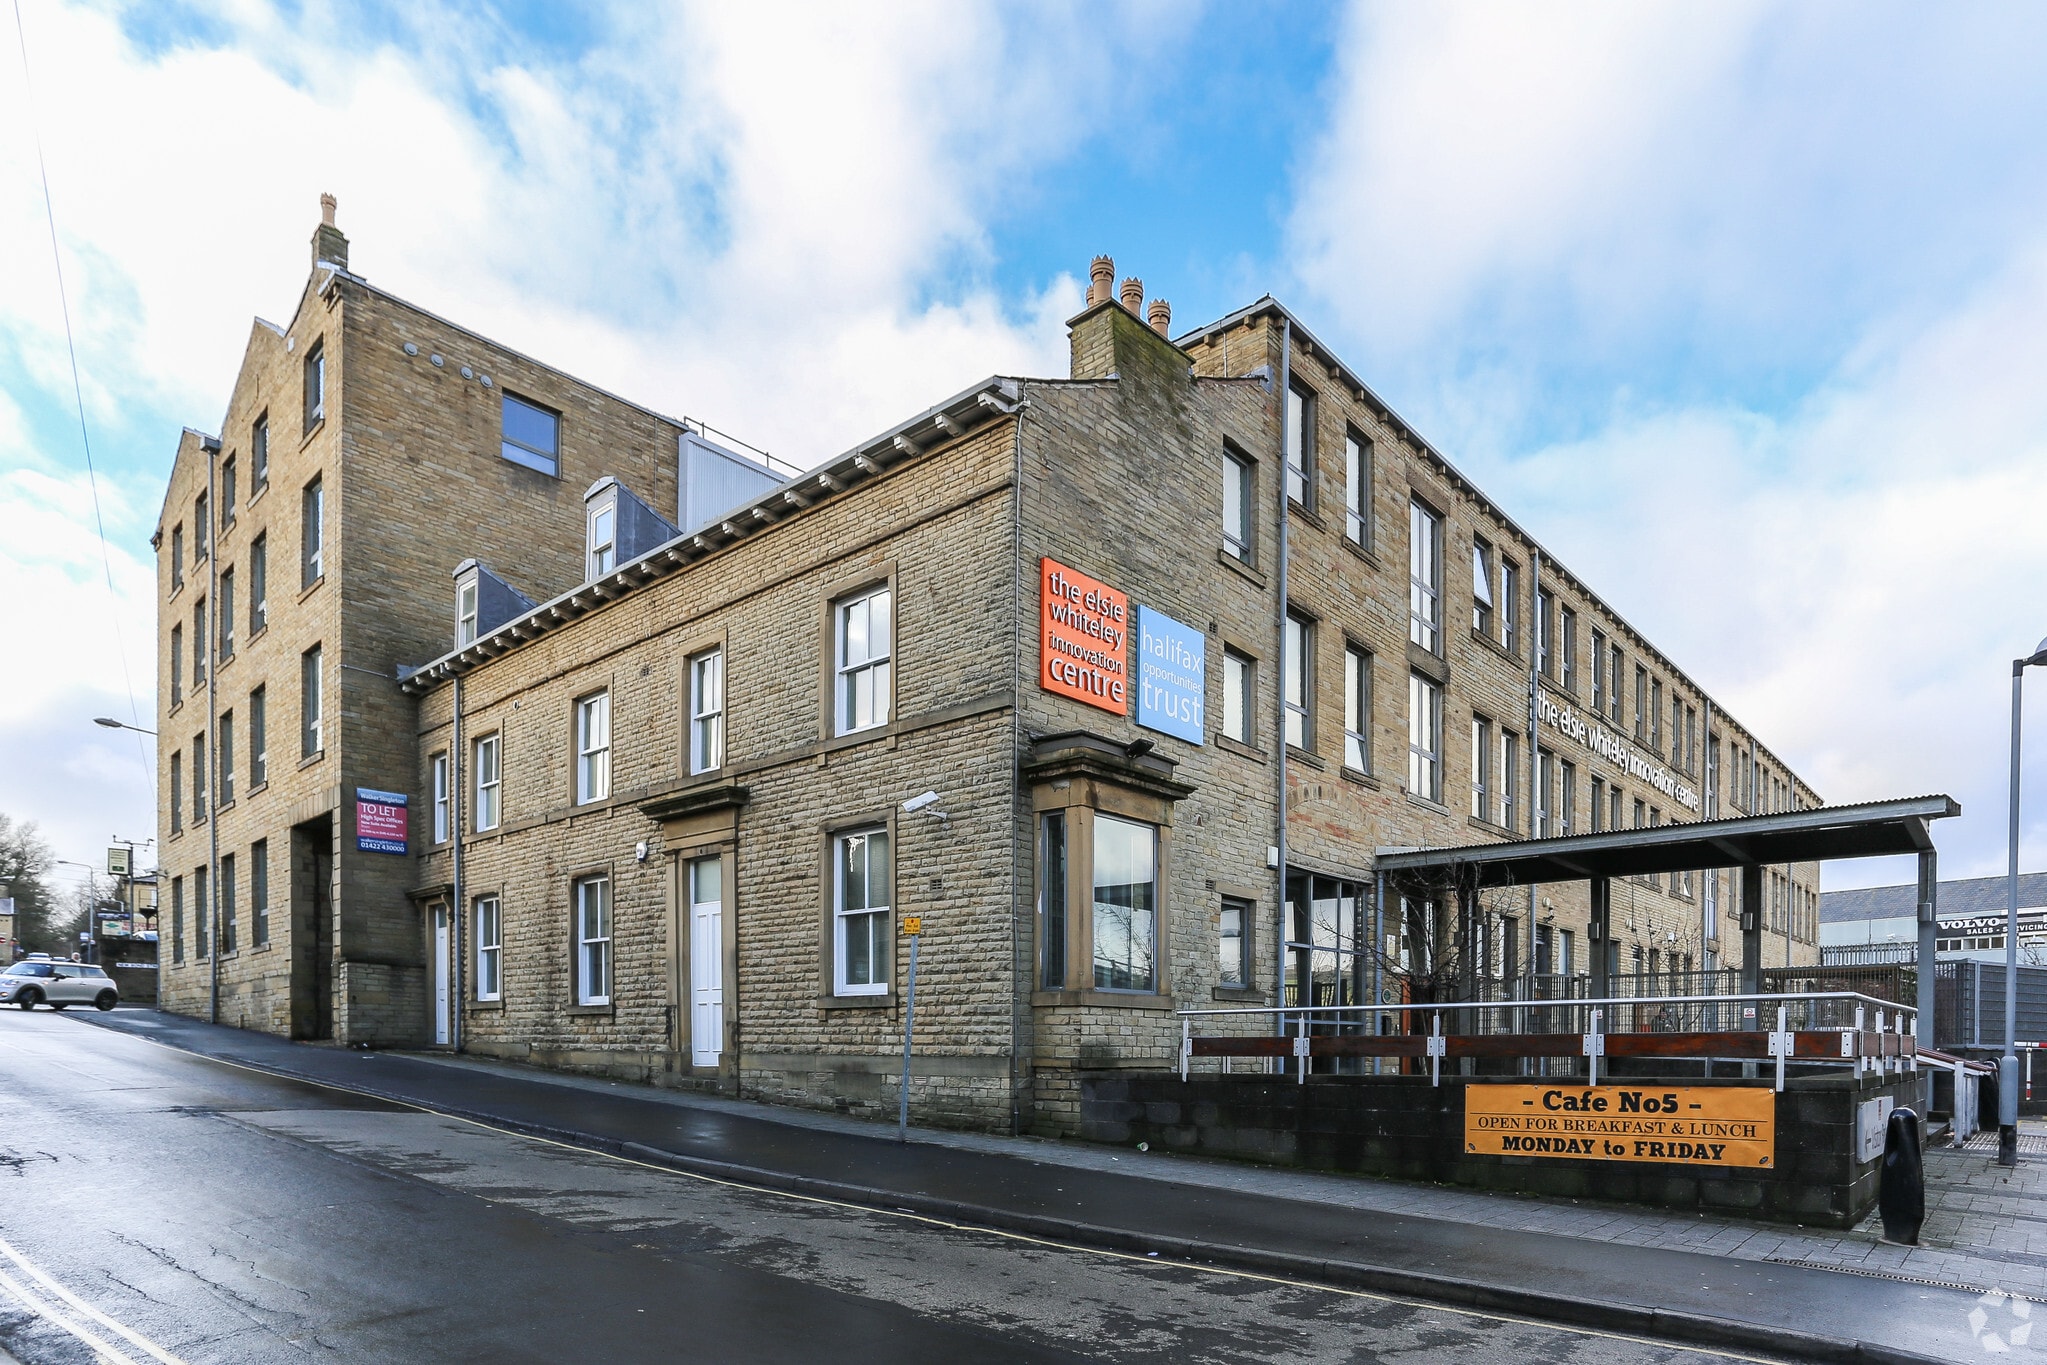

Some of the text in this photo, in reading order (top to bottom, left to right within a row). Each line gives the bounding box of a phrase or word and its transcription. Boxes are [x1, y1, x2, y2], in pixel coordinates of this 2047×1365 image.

[1050, 571, 1124, 622] the elsie
[1050, 601, 1124, 651] whiteley
[1050, 630, 1124, 674] innovation
[1143, 625, 1201, 674] halifax
[1050, 657, 1124, 702] centre
[1143, 662, 1202, 694] opportunities
[1142, 676, 1201, 728] trust
[1537, 689, 1699, 811] the elsie whiteley innovation centre
[361, 803, 397, 817] TO LET
[361, 842, 381, 850] 01422
[1937, 917, 2001, 930] VOLVO
[1966, 927, 1994, 935] SALES
[1542, 1090, 1608, 1112] Cafe
[1618, 1091, 1679, 1114] No5
[1477, 1116, 1757, 1138] OPEN FOR BREAKFAST & LUNCH
[1502, 1135, 1726, 1161] MONDAY to FRIDAY
